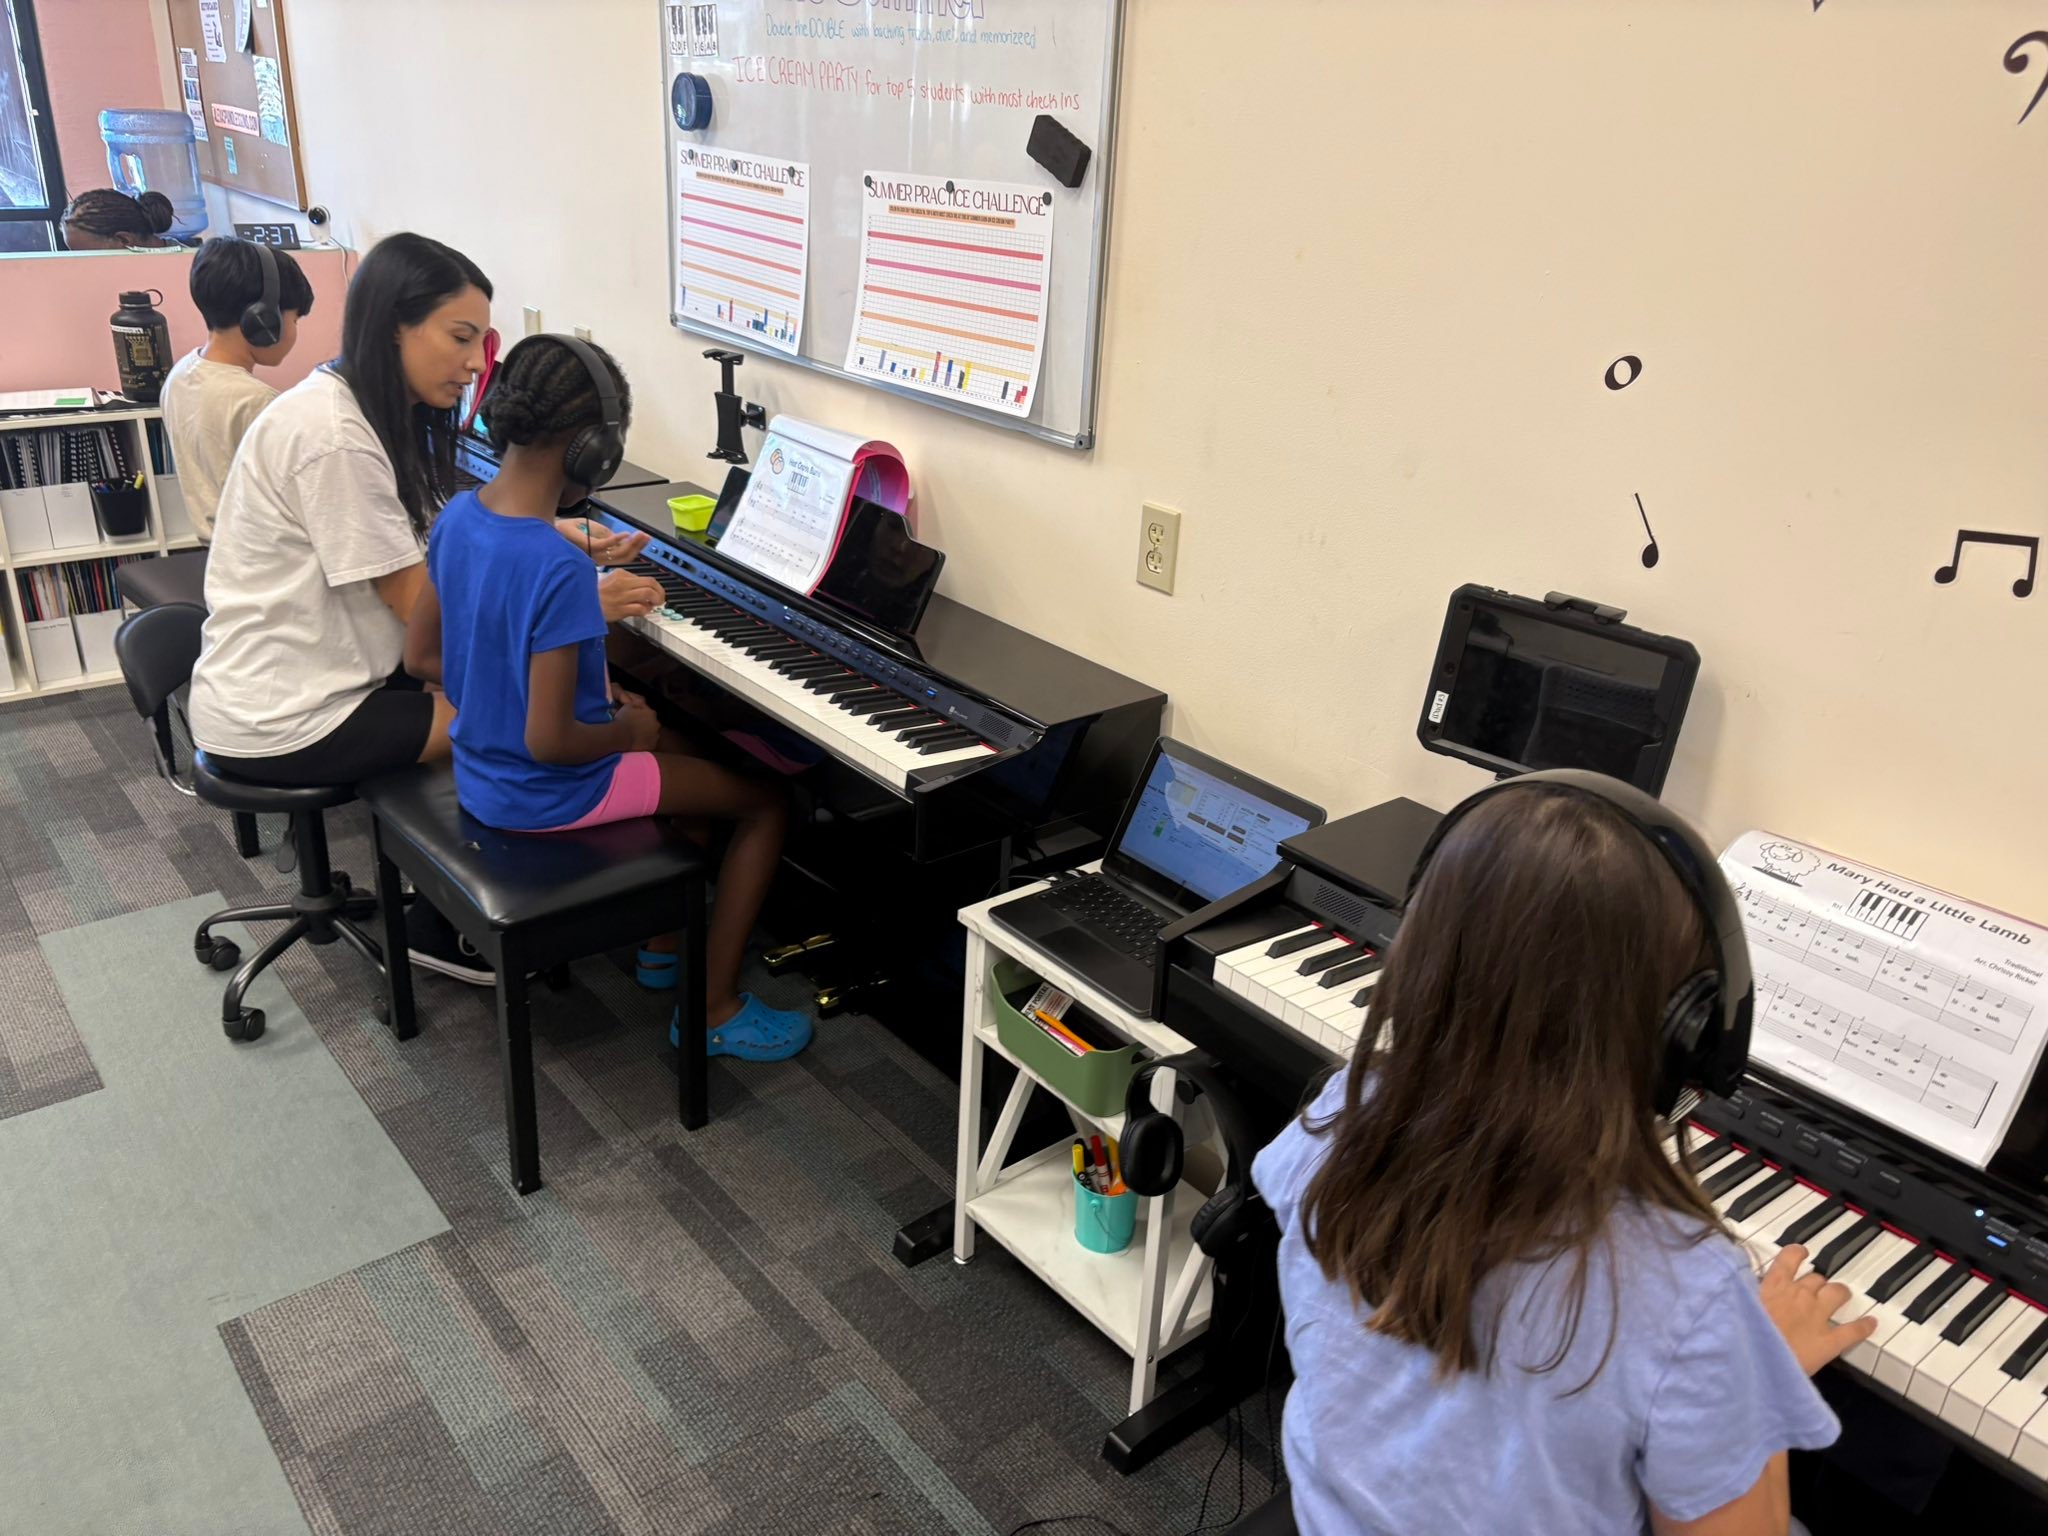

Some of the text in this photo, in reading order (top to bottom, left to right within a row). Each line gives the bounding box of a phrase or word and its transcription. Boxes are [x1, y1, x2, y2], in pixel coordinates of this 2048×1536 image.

[808, 17, 846, 40] DOUBLE
[732, 55, 766, 83] ICE
[767, 56, 816, 89] CREAM
[819, 60, 860, 96] PARTY
[865, 69, 881, 96] for
[886, 76, 904, 100] top
[920, 81, 965, 102] students
[971, 87, 996, 105] with
[998, 91, 1023, 109] most
[1025, 90, 1058, 110] check
[1060, 92, 1080, 111] ins
[868, 180, 913, 202] SUMMER
[973, 190, 1046, 217] CHALLENGE
[253, 226, 296, 245] 2:37
[1827, 862, 2032, 945] Mary Had a Little Lamb
[2004, 958, 2044, 978] Traditional
